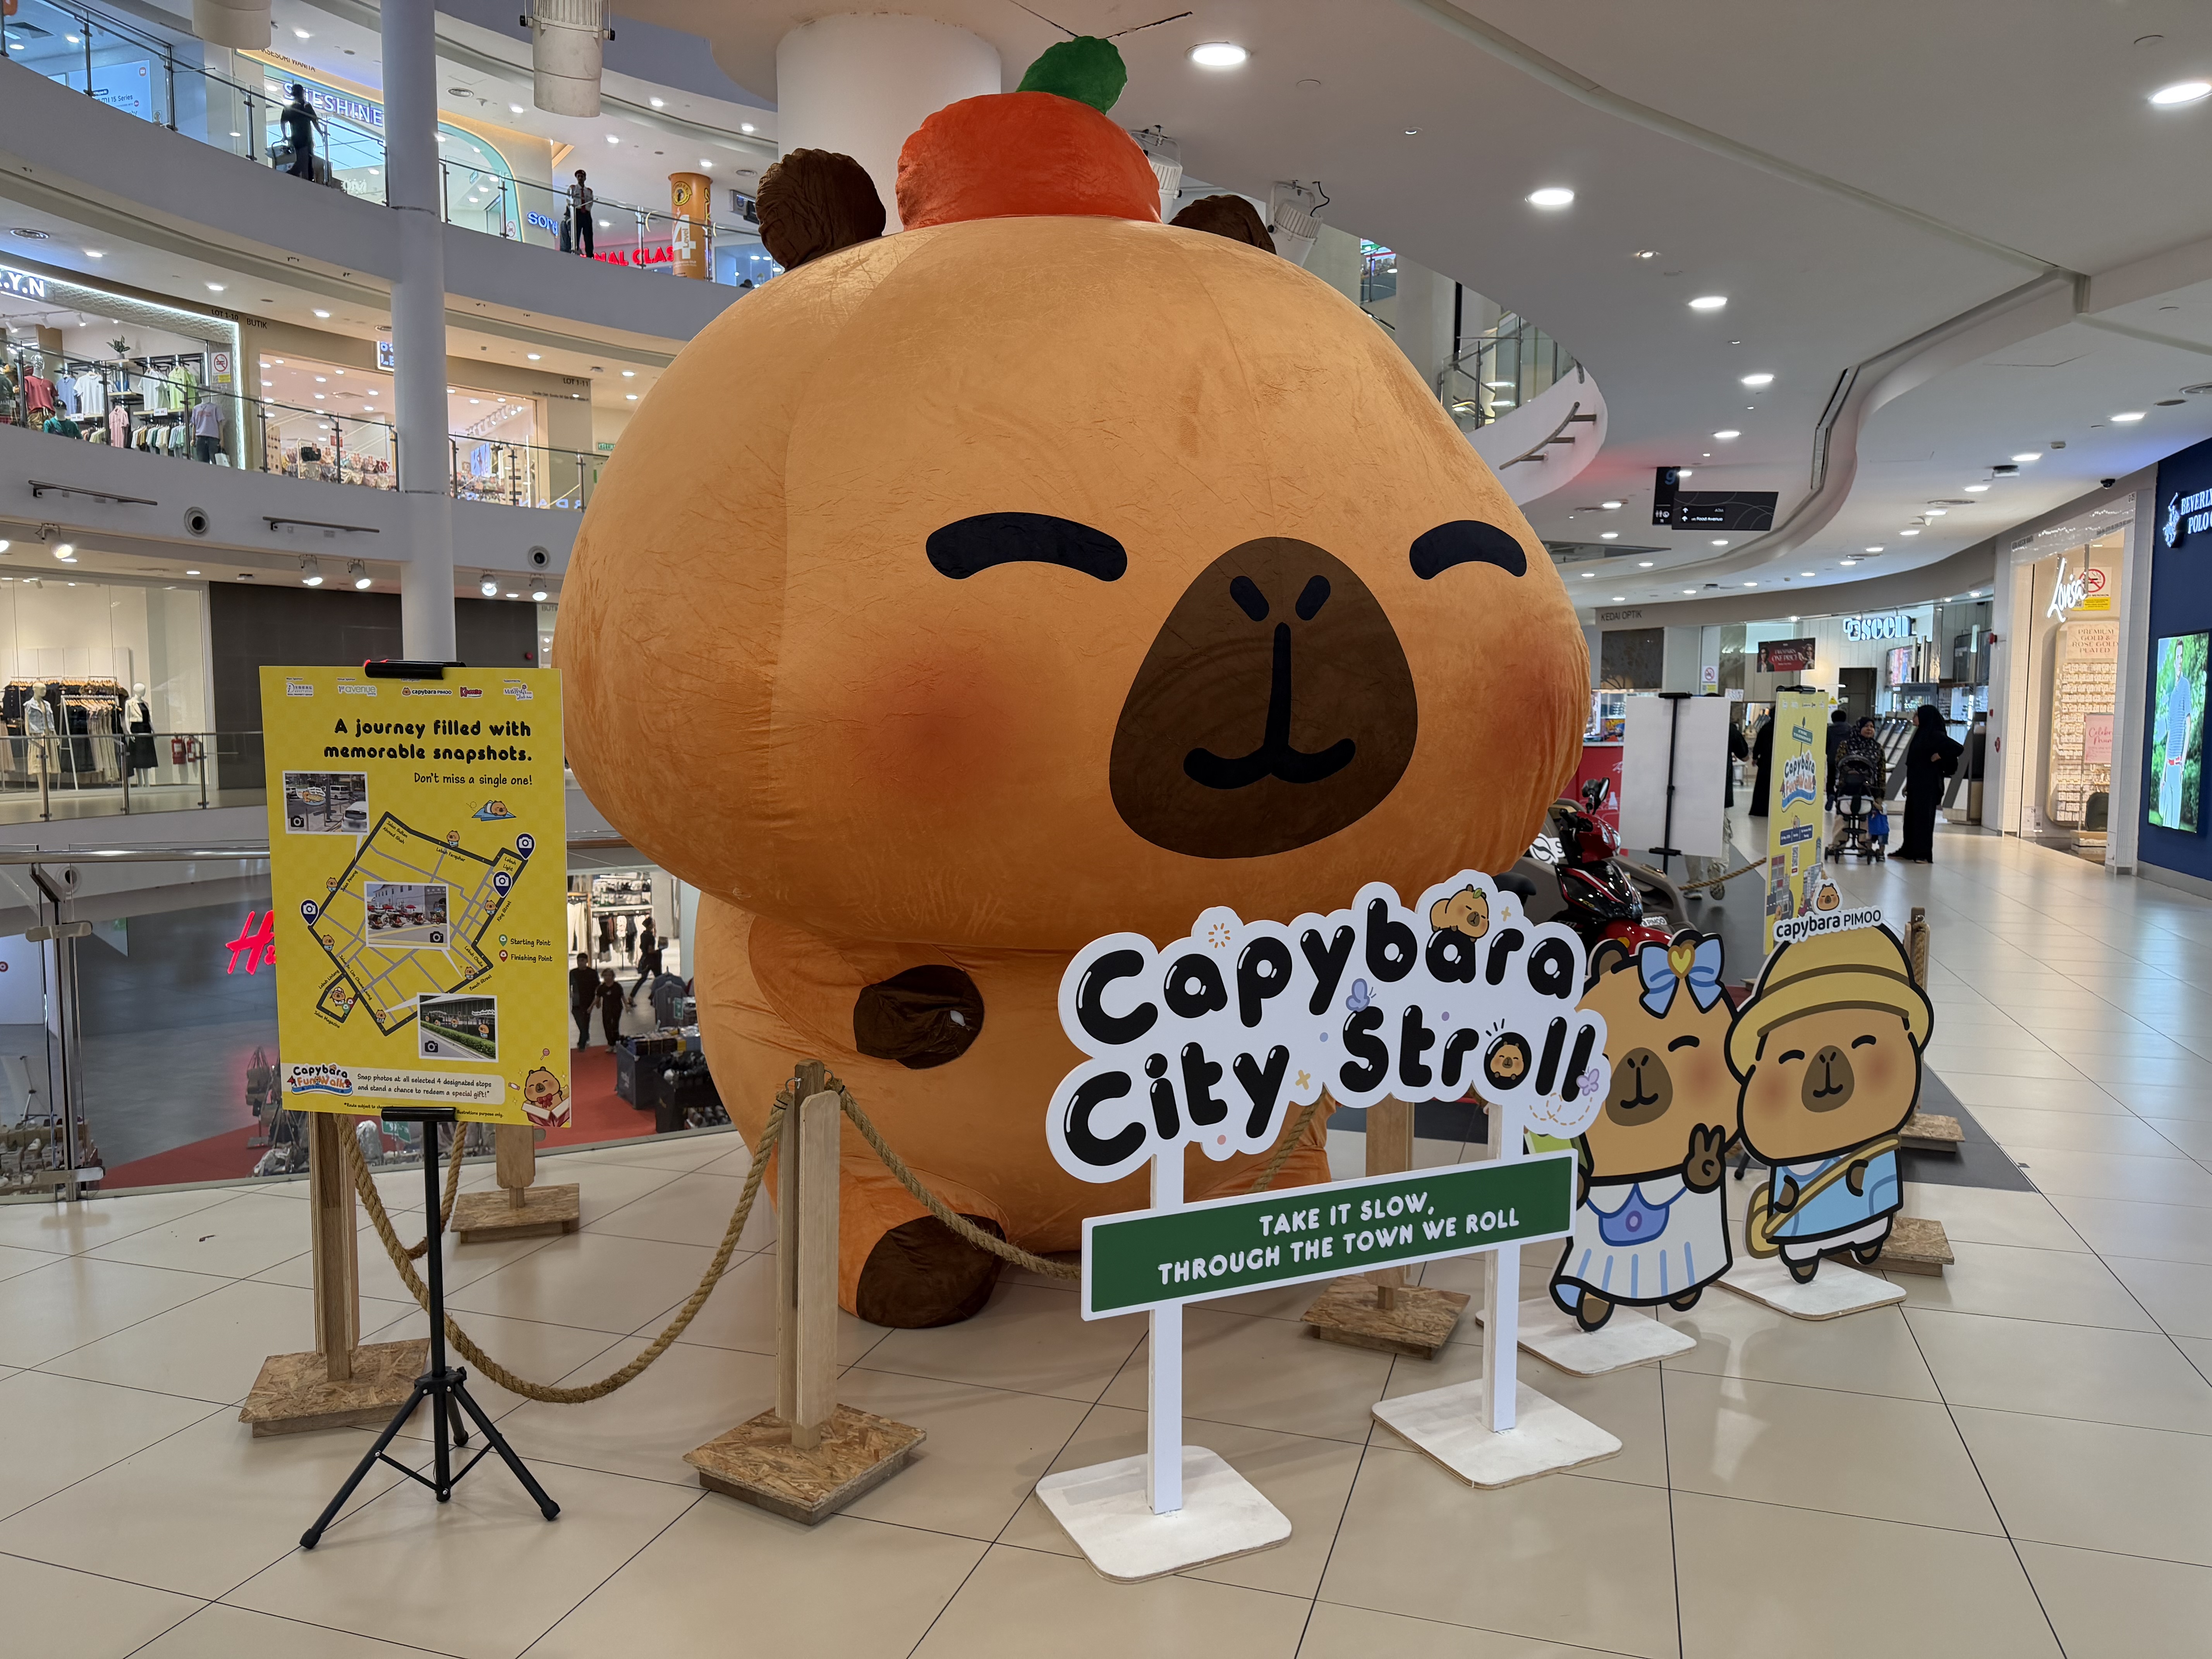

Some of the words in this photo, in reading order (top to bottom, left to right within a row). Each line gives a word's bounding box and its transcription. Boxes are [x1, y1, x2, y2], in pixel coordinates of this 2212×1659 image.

[292, 59, 315, 72] WANITA
[673, 214, 696, 259] 4
[225, 312, 239, 321] 1-10
[247, 318, 267, 329] BUTIK
[2188, 512, 2209, 534] POLO
[1601, 612, 1620, 622] KEDAI
[1622, 610, 1642, 620] OPTIK
[334, 718, 348, 734] A
[355, 718, 426, 739] journey
[433, 719, 481, 736] filled
[489, 720, 531, 737] with
[324, 743, 426, 759] memorable
[433, 745, 532, 764] snapshots.
[1784, 755, 1815, 778] Capybara
[414, 772, 440, 783] Don't
[443, 773, 465, 784] miss
[479, 774, 507, 788] single
[511, 775, 533, 785] one!
[503, 864, 514, 872] Light
[505, 856, 517, 866] Lebuh
[496, 912, 505, 922] King
[1776, 915, 1840, 939] capybara
[1844, 909, 1881, 927] PIMOO
[510, 938, 534, 947] Starting
[511, 954, 536, 963] Finishing
[1077, 897, 1575, 1044] Capybara
[480, 974, 493, 984] Street
[293, 1064, 348, 1079] Capybara
[319, 1075, 345, 1088] Walk
[357, 1073, 371, 1082] Snap
[373, 1074, 393, 1082] photos
[443, 1078, 474, 1087] designated
[476, 1080, 492, 1088] stops
[1063, 1042, 1290, 1166] City
[1340, 1005, 1596, 1102] Stroll
[1259, 1207, 1319, 1236] TAKE
[1330, 1203, 1351, 1226] IT
[1360, 1192, 1435, 1221] SLOW,
[1158, 1244, 1280, 1285] THROUGH
[1290, 1237, 1333, 1263] THE
[1342, 1223, 1413, 1254] TOWN
[1422, 1217, 1456, 1240] WE
[1466, 1207, 1520, 1234] ROLL
